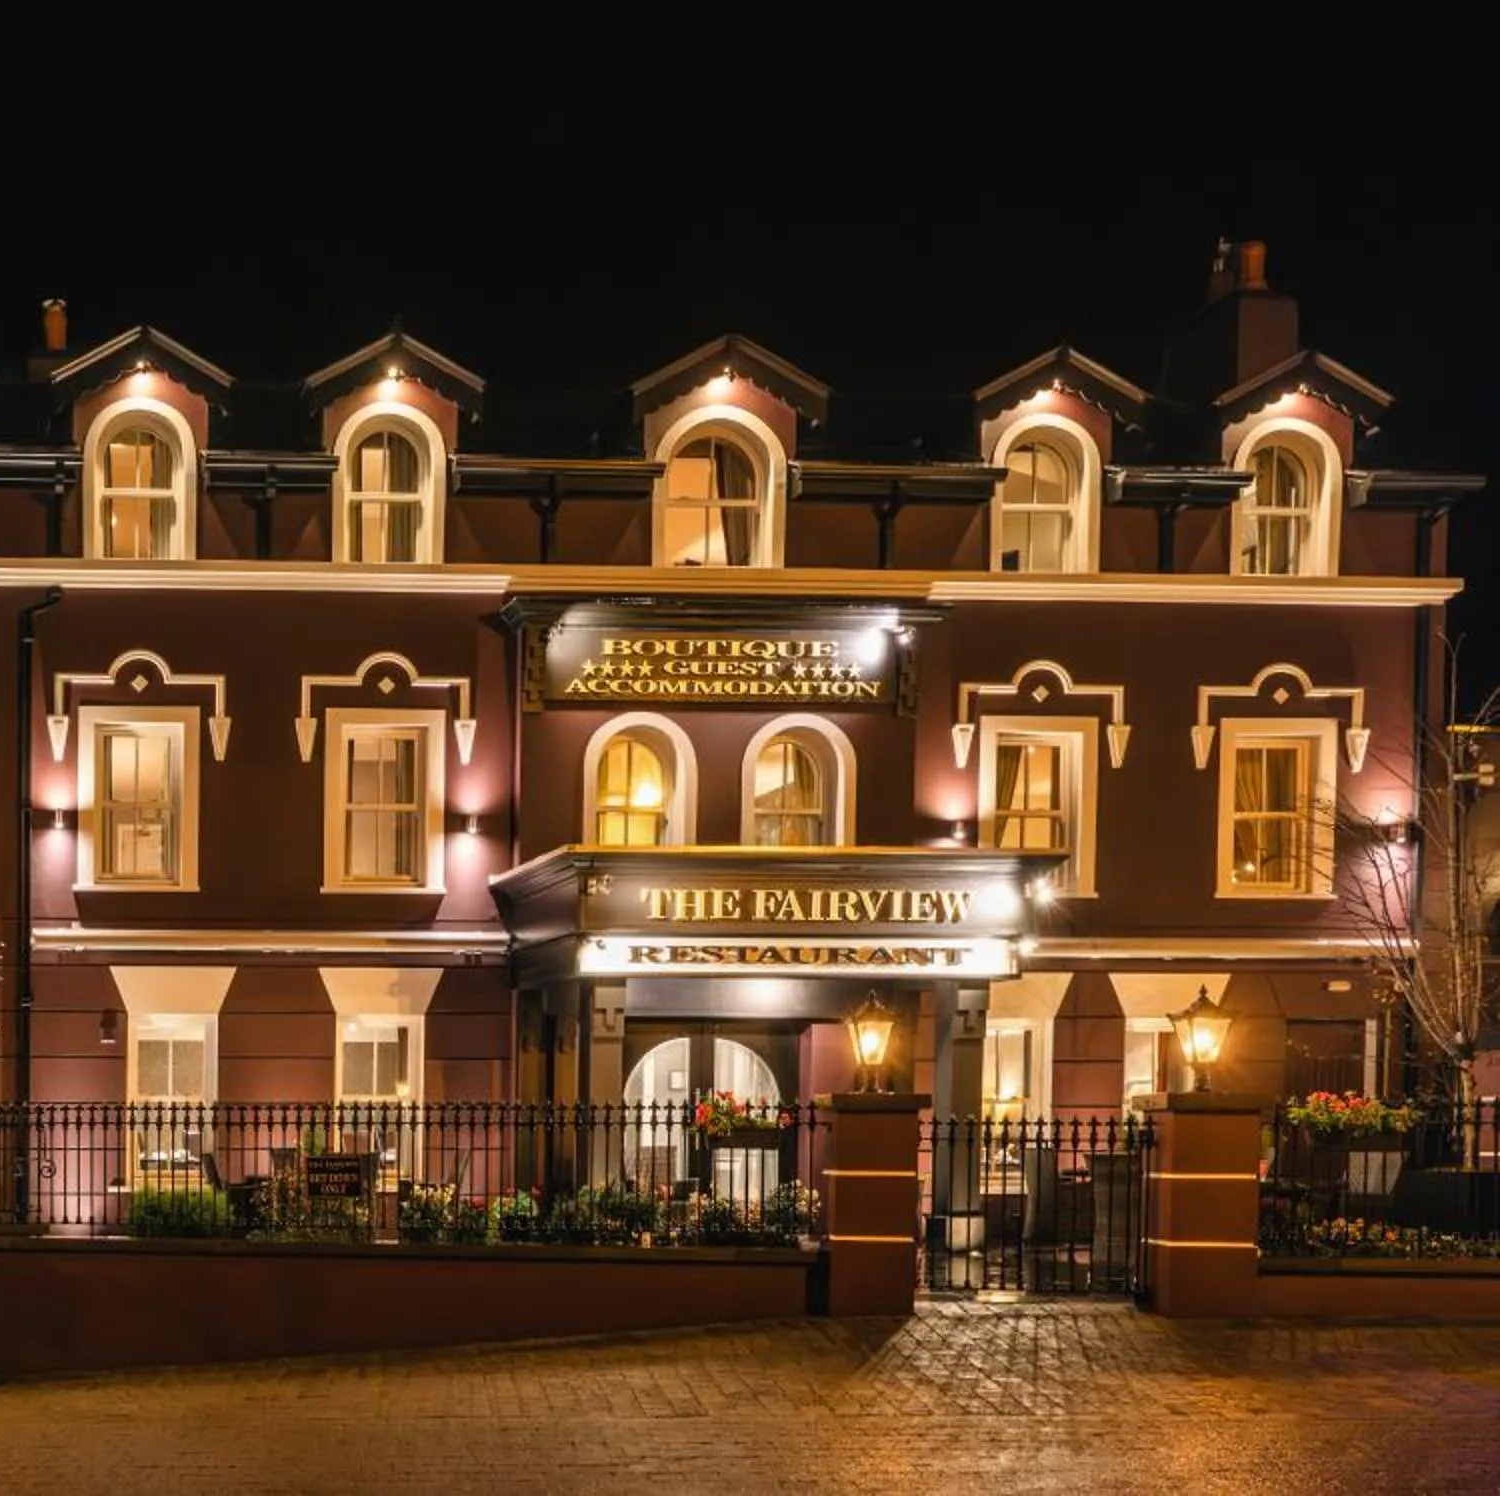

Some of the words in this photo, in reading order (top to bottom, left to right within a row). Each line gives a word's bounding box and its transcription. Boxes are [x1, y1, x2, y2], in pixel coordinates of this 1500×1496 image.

[602, 639, 839, 658] BOUTIQUE
[663, 661, 780, 675] GUEST
[565, 678, 881, 696] ACCOMMODATION
[640, 887, 742, 920] THE
[750, 887, 978, 923] FAIRVIEW
[627, 945, 974, 965] RESTAURANT
